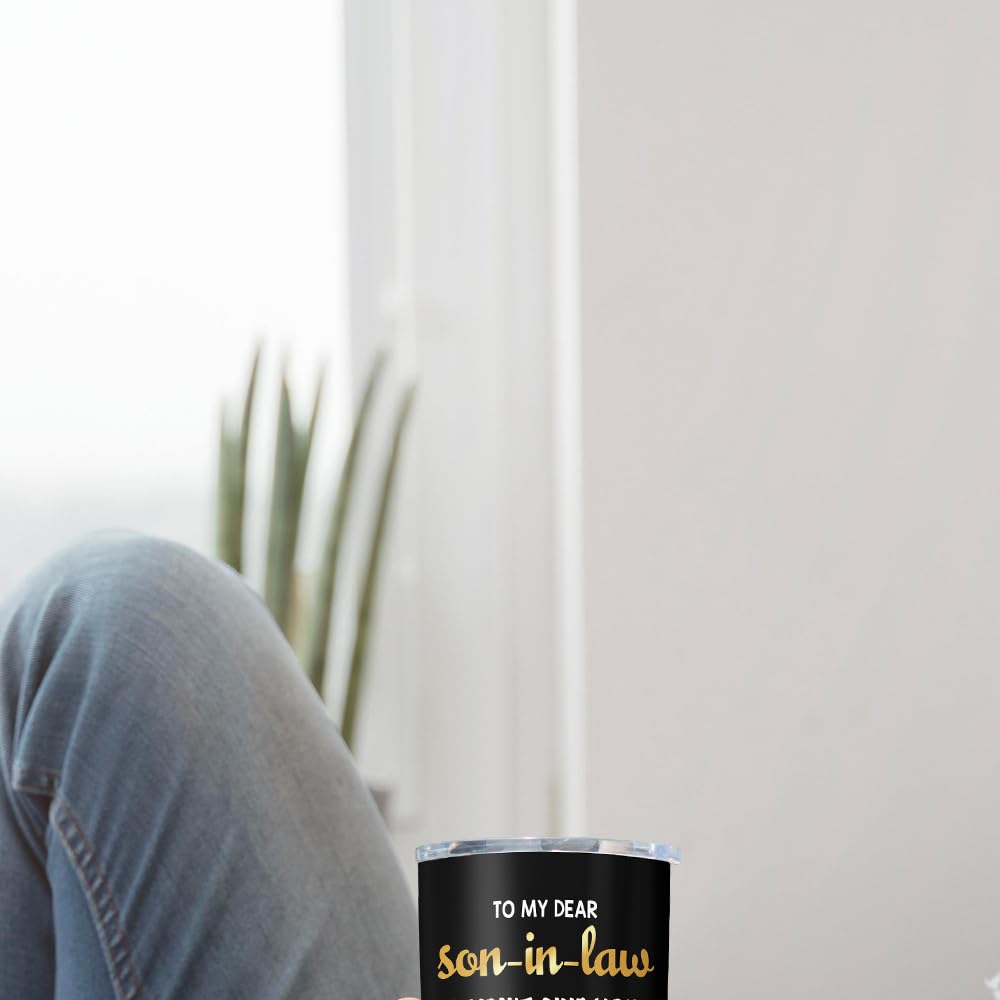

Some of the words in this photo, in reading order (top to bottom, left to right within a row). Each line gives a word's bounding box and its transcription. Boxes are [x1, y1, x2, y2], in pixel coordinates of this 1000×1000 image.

[492, 899, 515, 919] TO
[520, 899, 549, 918] MY
[554, 899, 598, 919] DEAR
[437, 924, 655, 980] son-in-law
